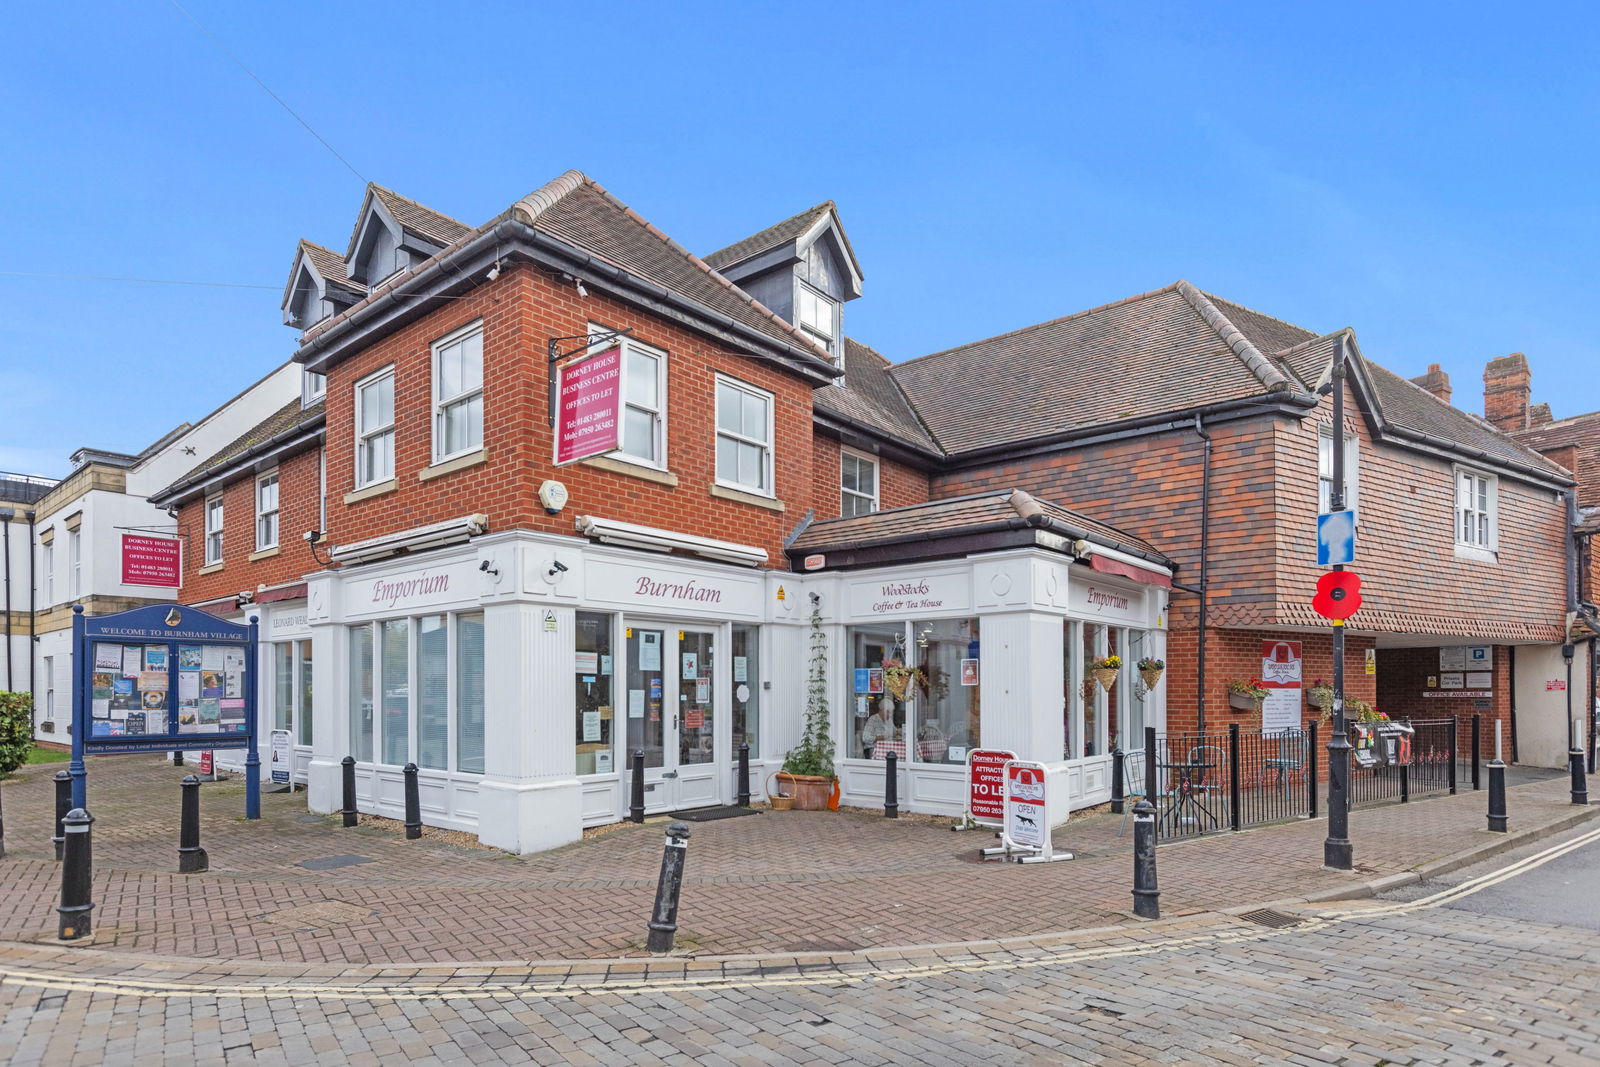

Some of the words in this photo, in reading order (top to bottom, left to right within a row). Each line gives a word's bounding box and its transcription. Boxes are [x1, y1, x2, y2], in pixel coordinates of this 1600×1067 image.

[566, 365, 593, 381] DORNEY
[593, 355, 616, 370] HOUSE
[562, 379, 592, 395] BUSINESS
[592, 368, 620, 383] CENTRE
[565, 396, 591, 410] OFFICES
[591, 391, 600, 401] TO
[600, 388, 613, 398] LET
[566, 421, 576, 429] Tel:
[372, 572, 449, 608] Emporium
[635, 576, 722, 603] Burnham
[872, 600, 894, 613] Coffee
[905, 600, 918, 609] Tea
[919, 599, 943, 608] House
[1087, 587, 1128, 611] Emporium
[100, 627, 147, 636] WELCOME
[149, 629, 162, 637] TO
[164, 630, 208, 639] BURNHAM
[210, 632, 243, 640] VILLAGE
[973, 754, 993, 763] Dorney
[975, 766, 1003, 774] ATTRACTI
[972, 783, 988, 795] TO
[991, 784, 1004, 796] LE
[1018, 804, 1036, 815] OPEN
